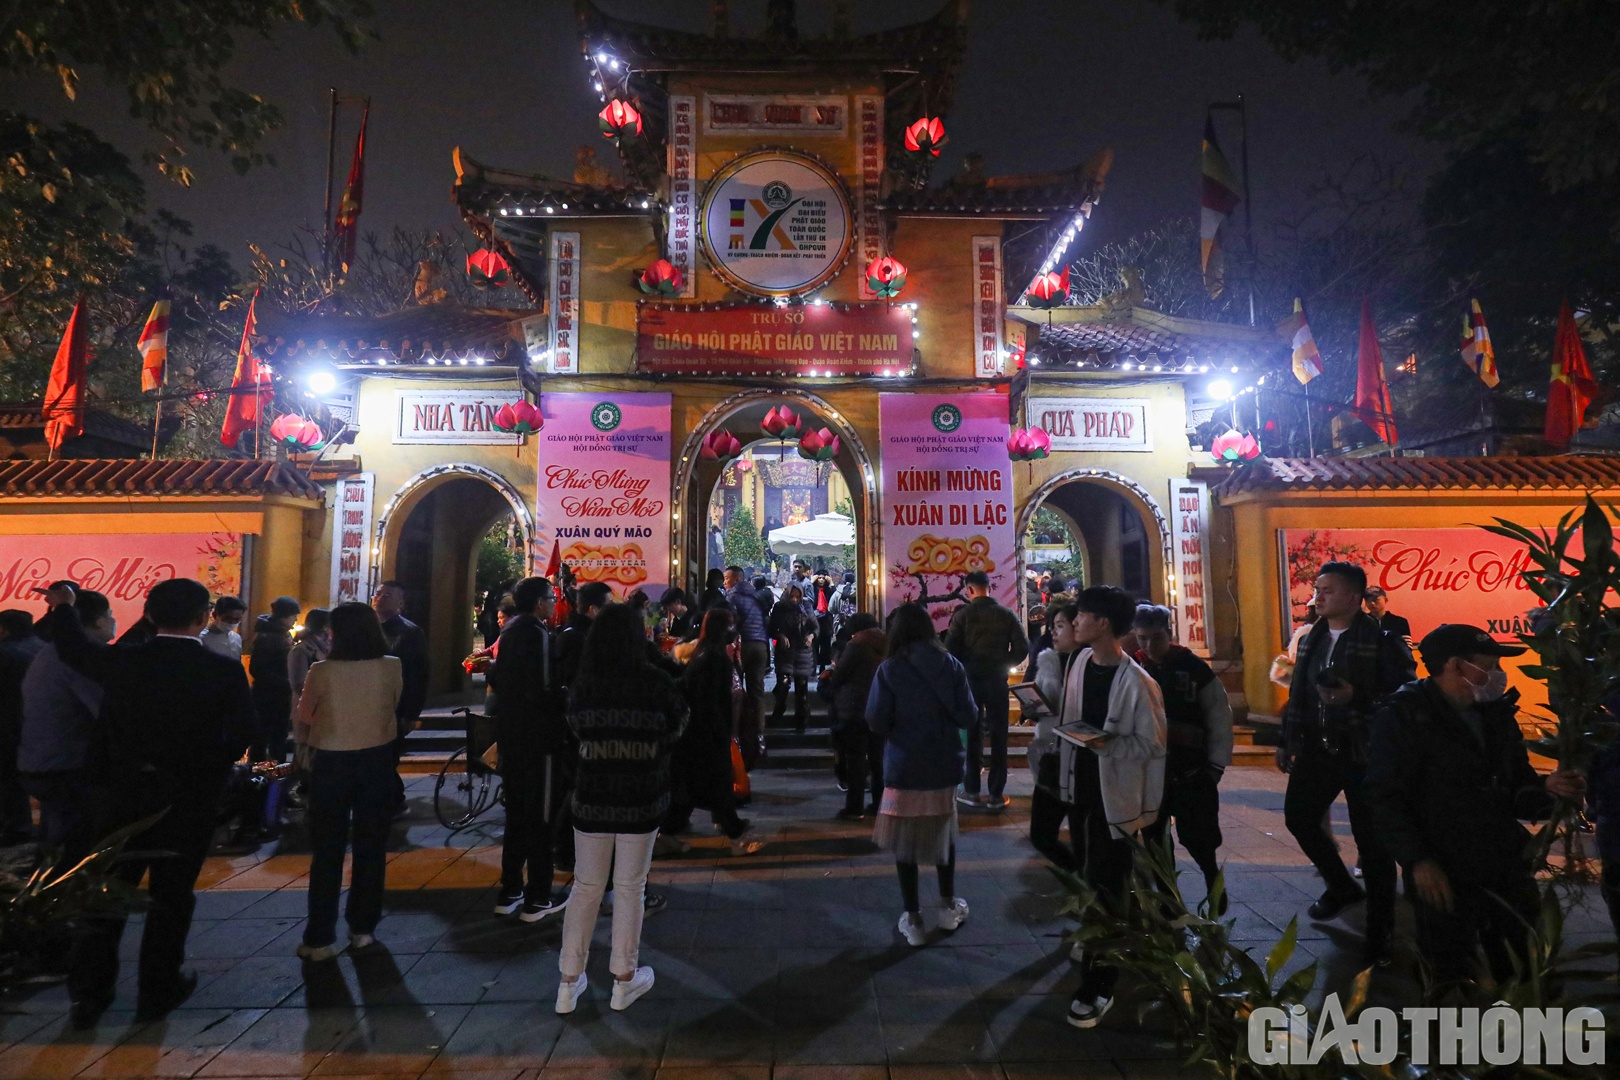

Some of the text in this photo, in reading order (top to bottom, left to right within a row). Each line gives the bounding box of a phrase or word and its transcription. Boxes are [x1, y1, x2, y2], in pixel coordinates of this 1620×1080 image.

[750, 310, 804, 326] TRỤ SỞ
[653, 329, 898, 354] GIÁO HỘI PHẬT GIÁO VIỆT NAM
[460, 401, 503, 432] TĂN
[1083, 411, 1134, 438] PHÁP
[568, 434, 582, 443] HỘI
[584, 434, 605, 443] PHẬT
[627, 434, 644, 443] VIỆT
[573, 443, 638, 453] HỘI ĐỒNG TRỊ SỰ
[890, 435, 909, 443] GIÁO
[911, 435, 925, 444] HỘI
[926, 435, 946, 443] PHẬT
[948, 435, 967, 443] GIÁO
[968, 435, 986, 443] VIỆT
[916, 444, 980, 454] HỘI ĐỒNG TRỊ SỰ
[545, 465, 651, 498] Chúc Mừng
[897, 466, 1001, 491] KÍNH MỪNG
[611, 498, 664, 517] Mới
[893, 500, 1007, 530] XUÂN DI LẶC
[555, 525, 652, 538] XUÂN QUÝ MÃO
[908, 534, 996, 575] 2023
[1372, 539, 1469, 592] Chúc
